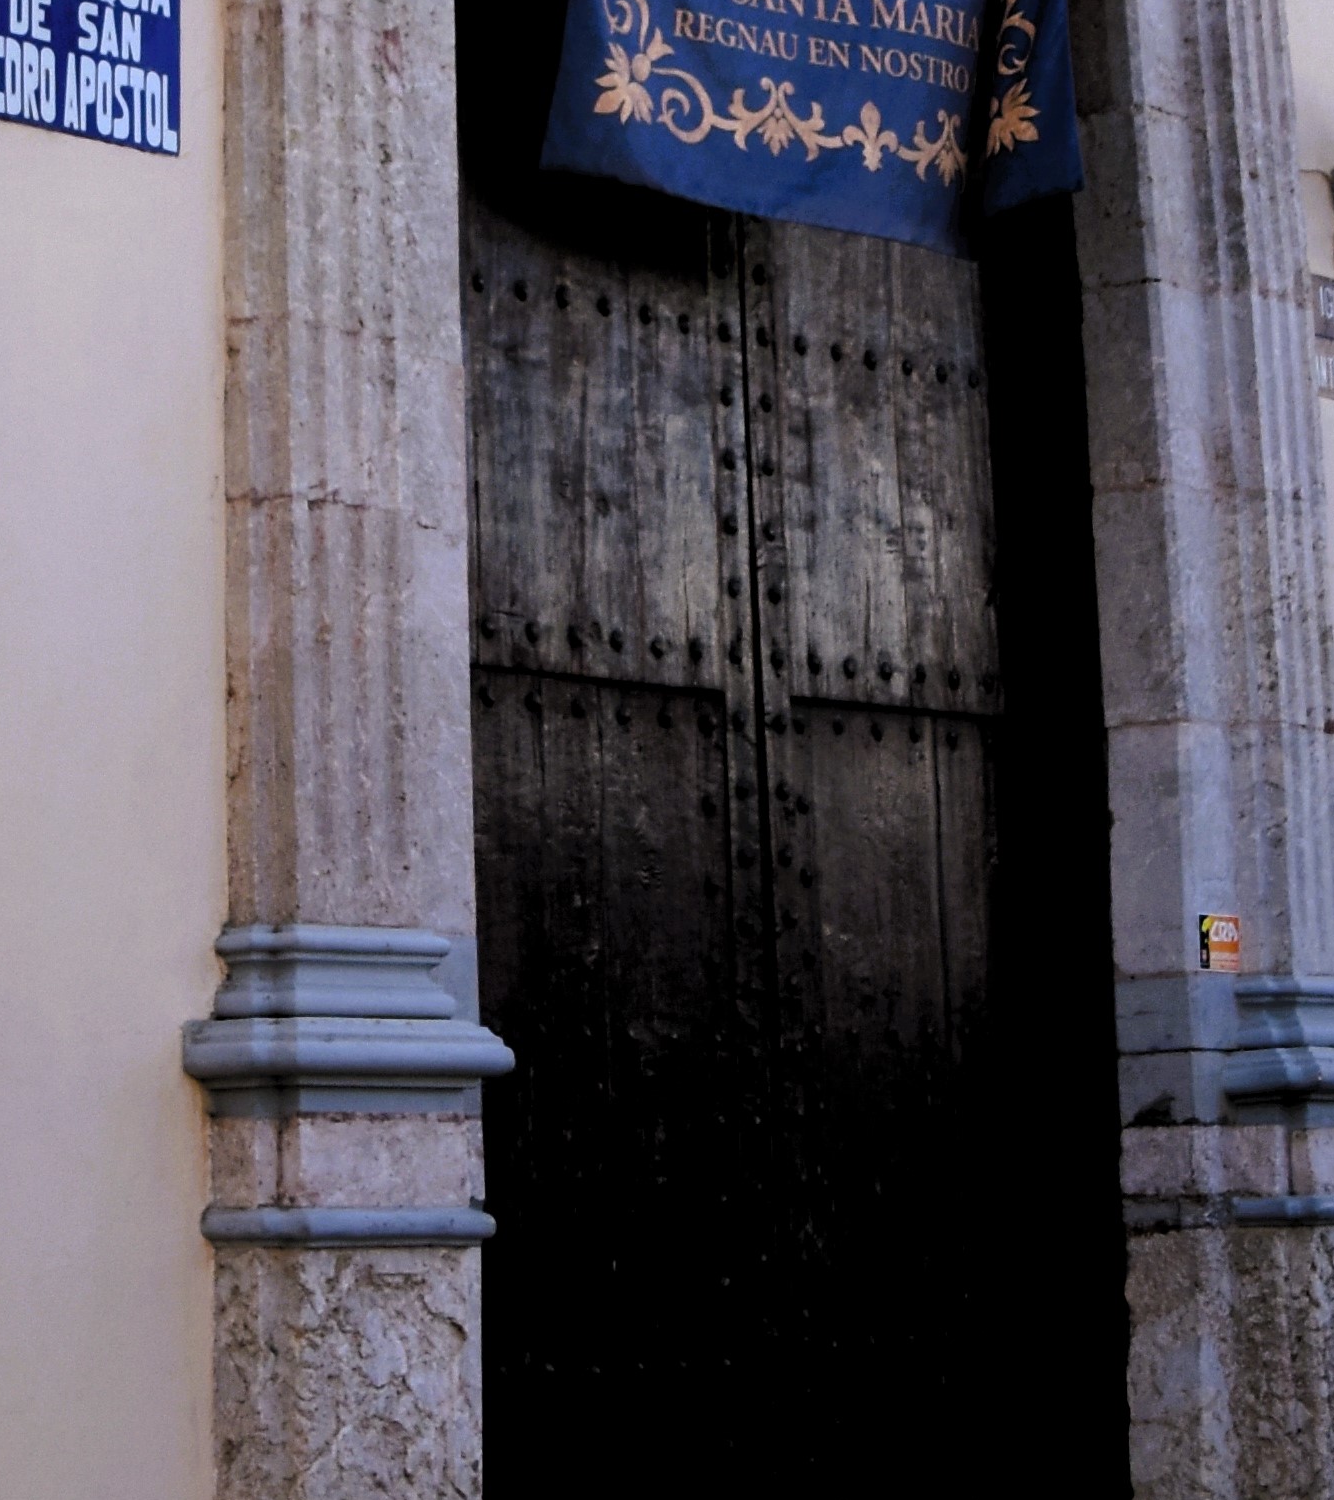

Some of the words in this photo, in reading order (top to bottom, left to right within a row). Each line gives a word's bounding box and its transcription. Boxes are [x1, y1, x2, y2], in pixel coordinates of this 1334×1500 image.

[78, 2, 142, 63] SAN
[673, 7, 799, 61] REGNAU
[808, 36, 851, 70] EN
[63, 51, 178, 153] APOSTOL
